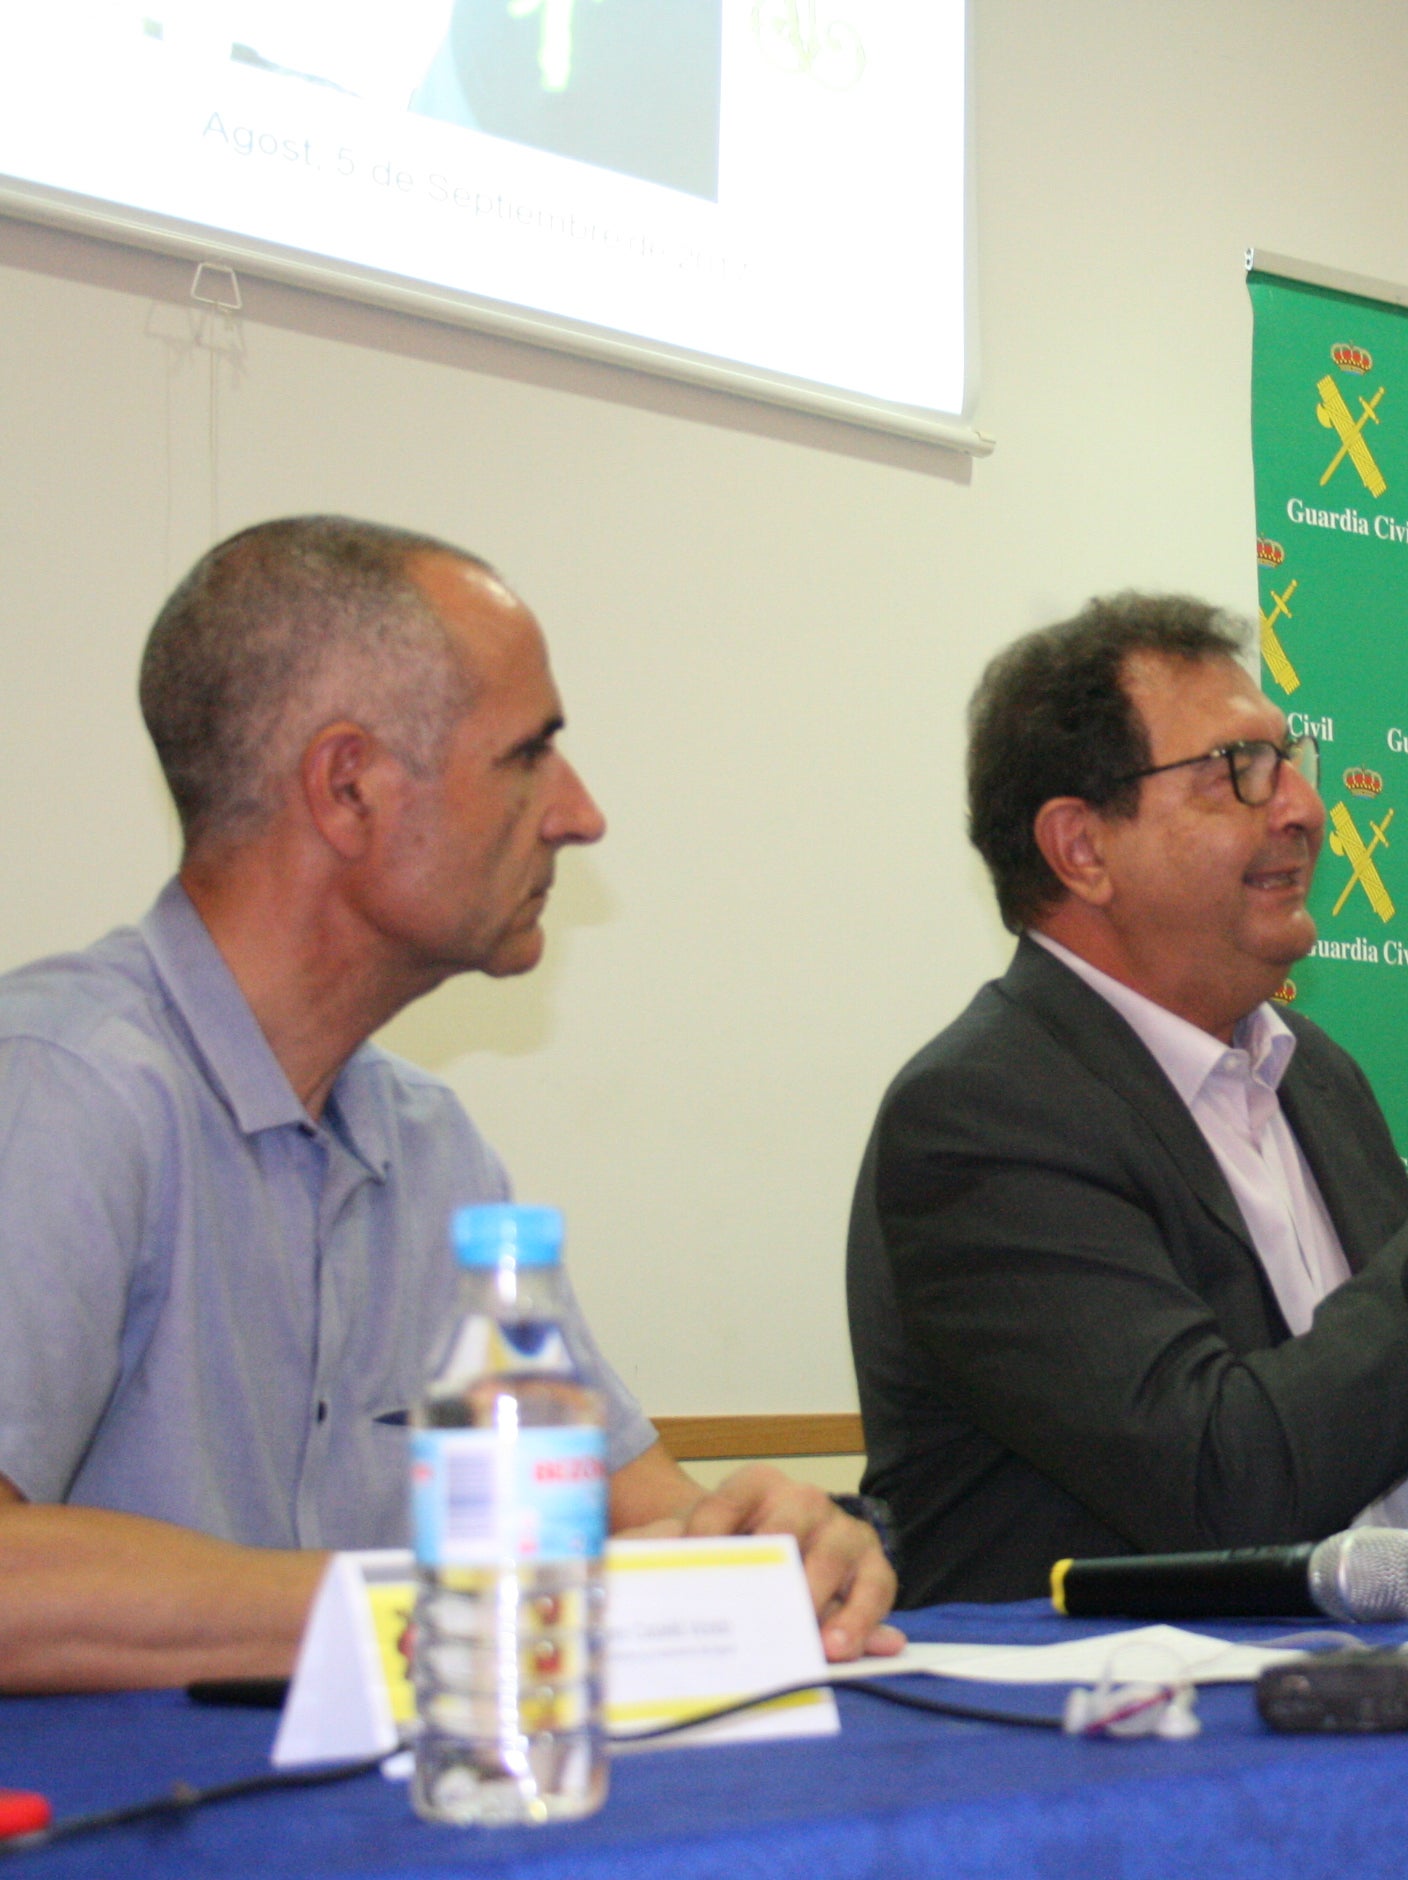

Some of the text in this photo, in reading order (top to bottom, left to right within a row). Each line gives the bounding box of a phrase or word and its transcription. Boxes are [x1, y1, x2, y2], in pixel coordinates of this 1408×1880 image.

[336, 147, 357, 177] 5
[371, 159, 415, 194] de
[427, 172, 623, 246] Septiembre
[1287, 498, 1369, 535] Guardia
[1286, 713, 1333, 741] Civil
[1308, 937, 1378, 963] uardia
